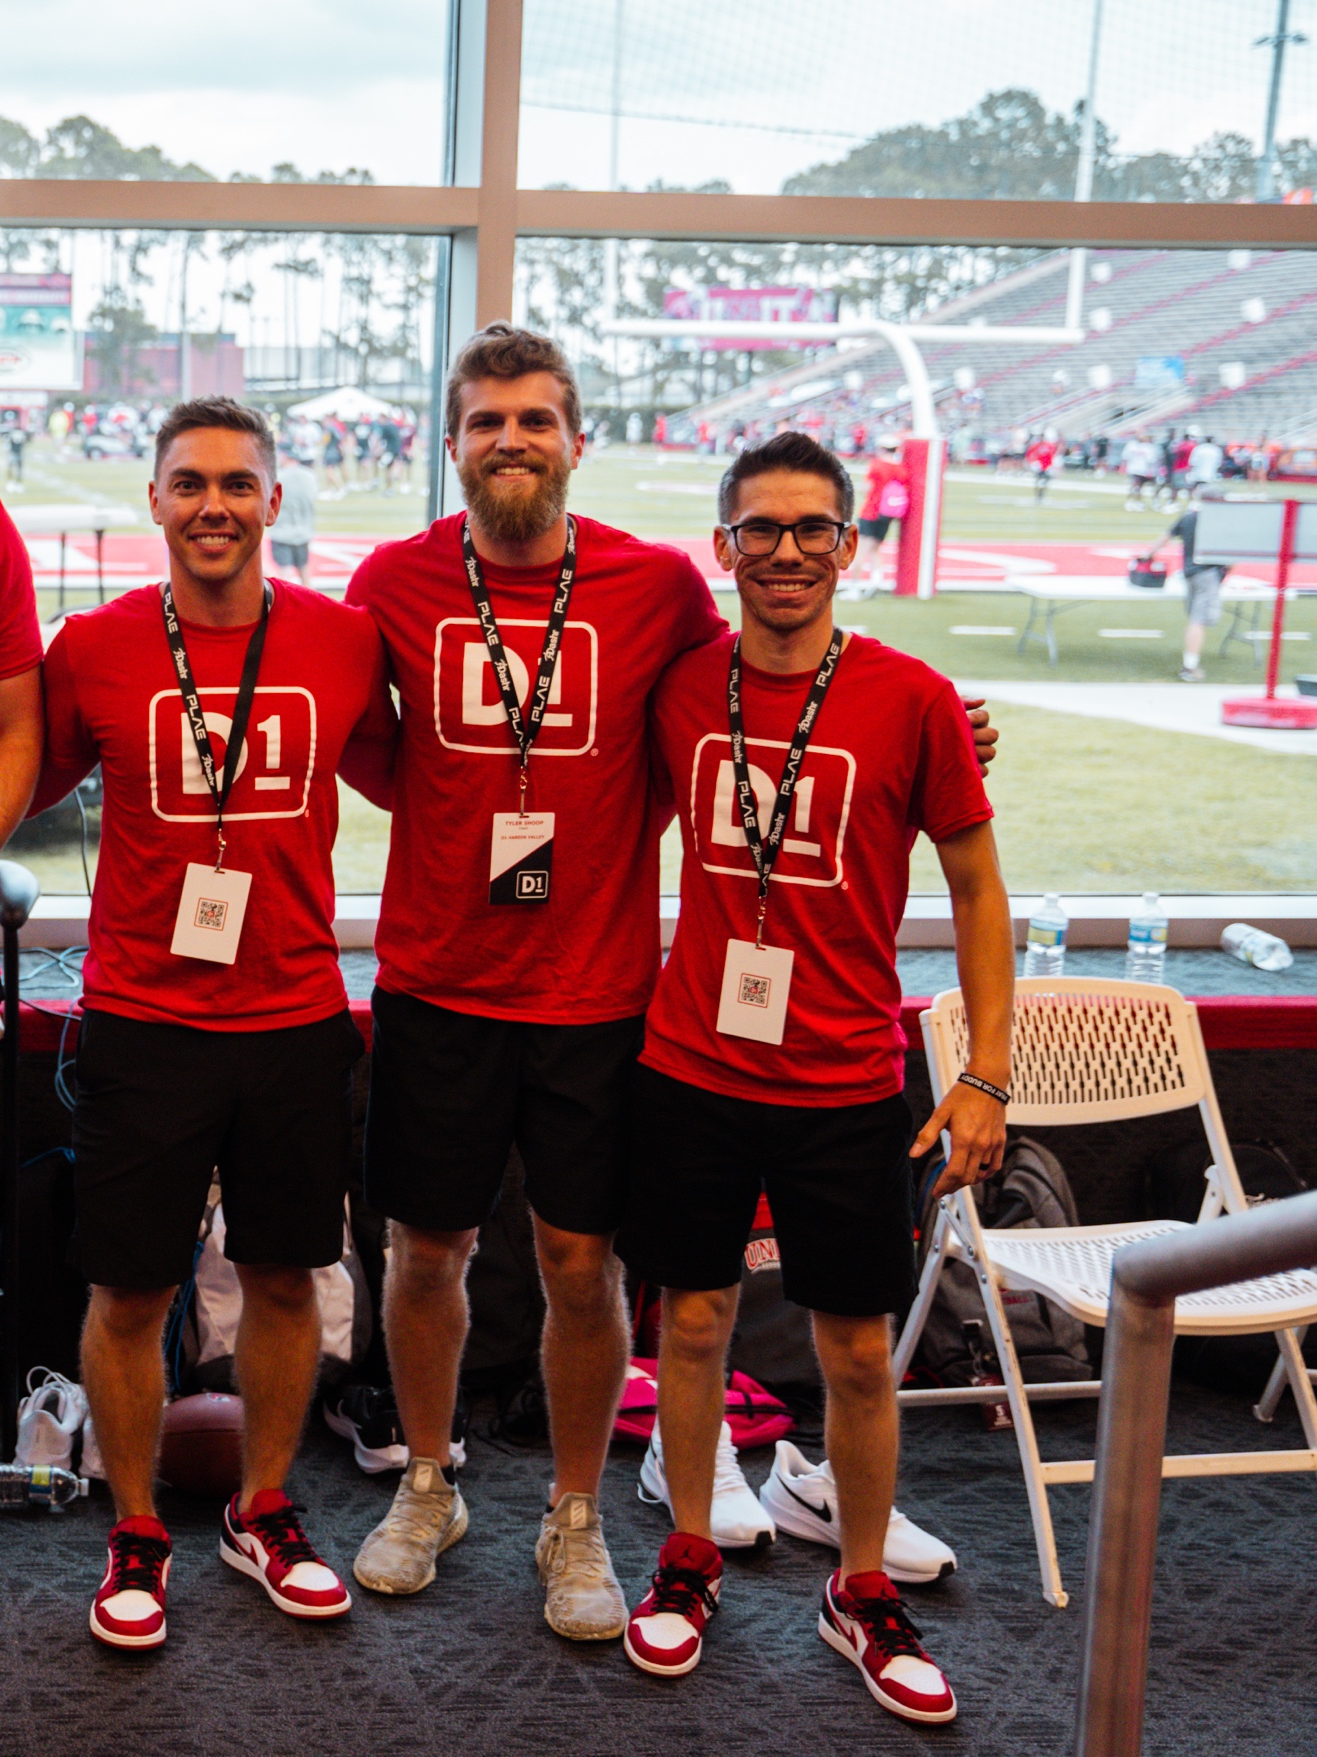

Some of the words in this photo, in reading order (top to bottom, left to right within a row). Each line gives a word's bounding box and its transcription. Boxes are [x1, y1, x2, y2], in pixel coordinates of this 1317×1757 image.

[465, 557, 479, 587] Dashr
[553, 568, 573, 613] PLAE
[164, 592, 179, 634] PLAE
[477, 601, 499, 647] PLAE
[173, 648, 187, 679] Dashr
[542, 629, 560, 661] Dashr
[815, 642, 840, 687] PLAE
[494, 659, 511, 692] Dashr
[729, 668, 740, 714] PLAE
[186, 694, 207, 741] PLAE
[531, 676, 551, 722] PLAE
[798, 700, 818, 734] Dashr
[181, 712, 290, 794] D1
[780, 748, 803, 796] PLAE
[711, 759, 821, 857] D1
[738, 780, 757, 829] PLAE
[522, 875, 544, 893] D1
